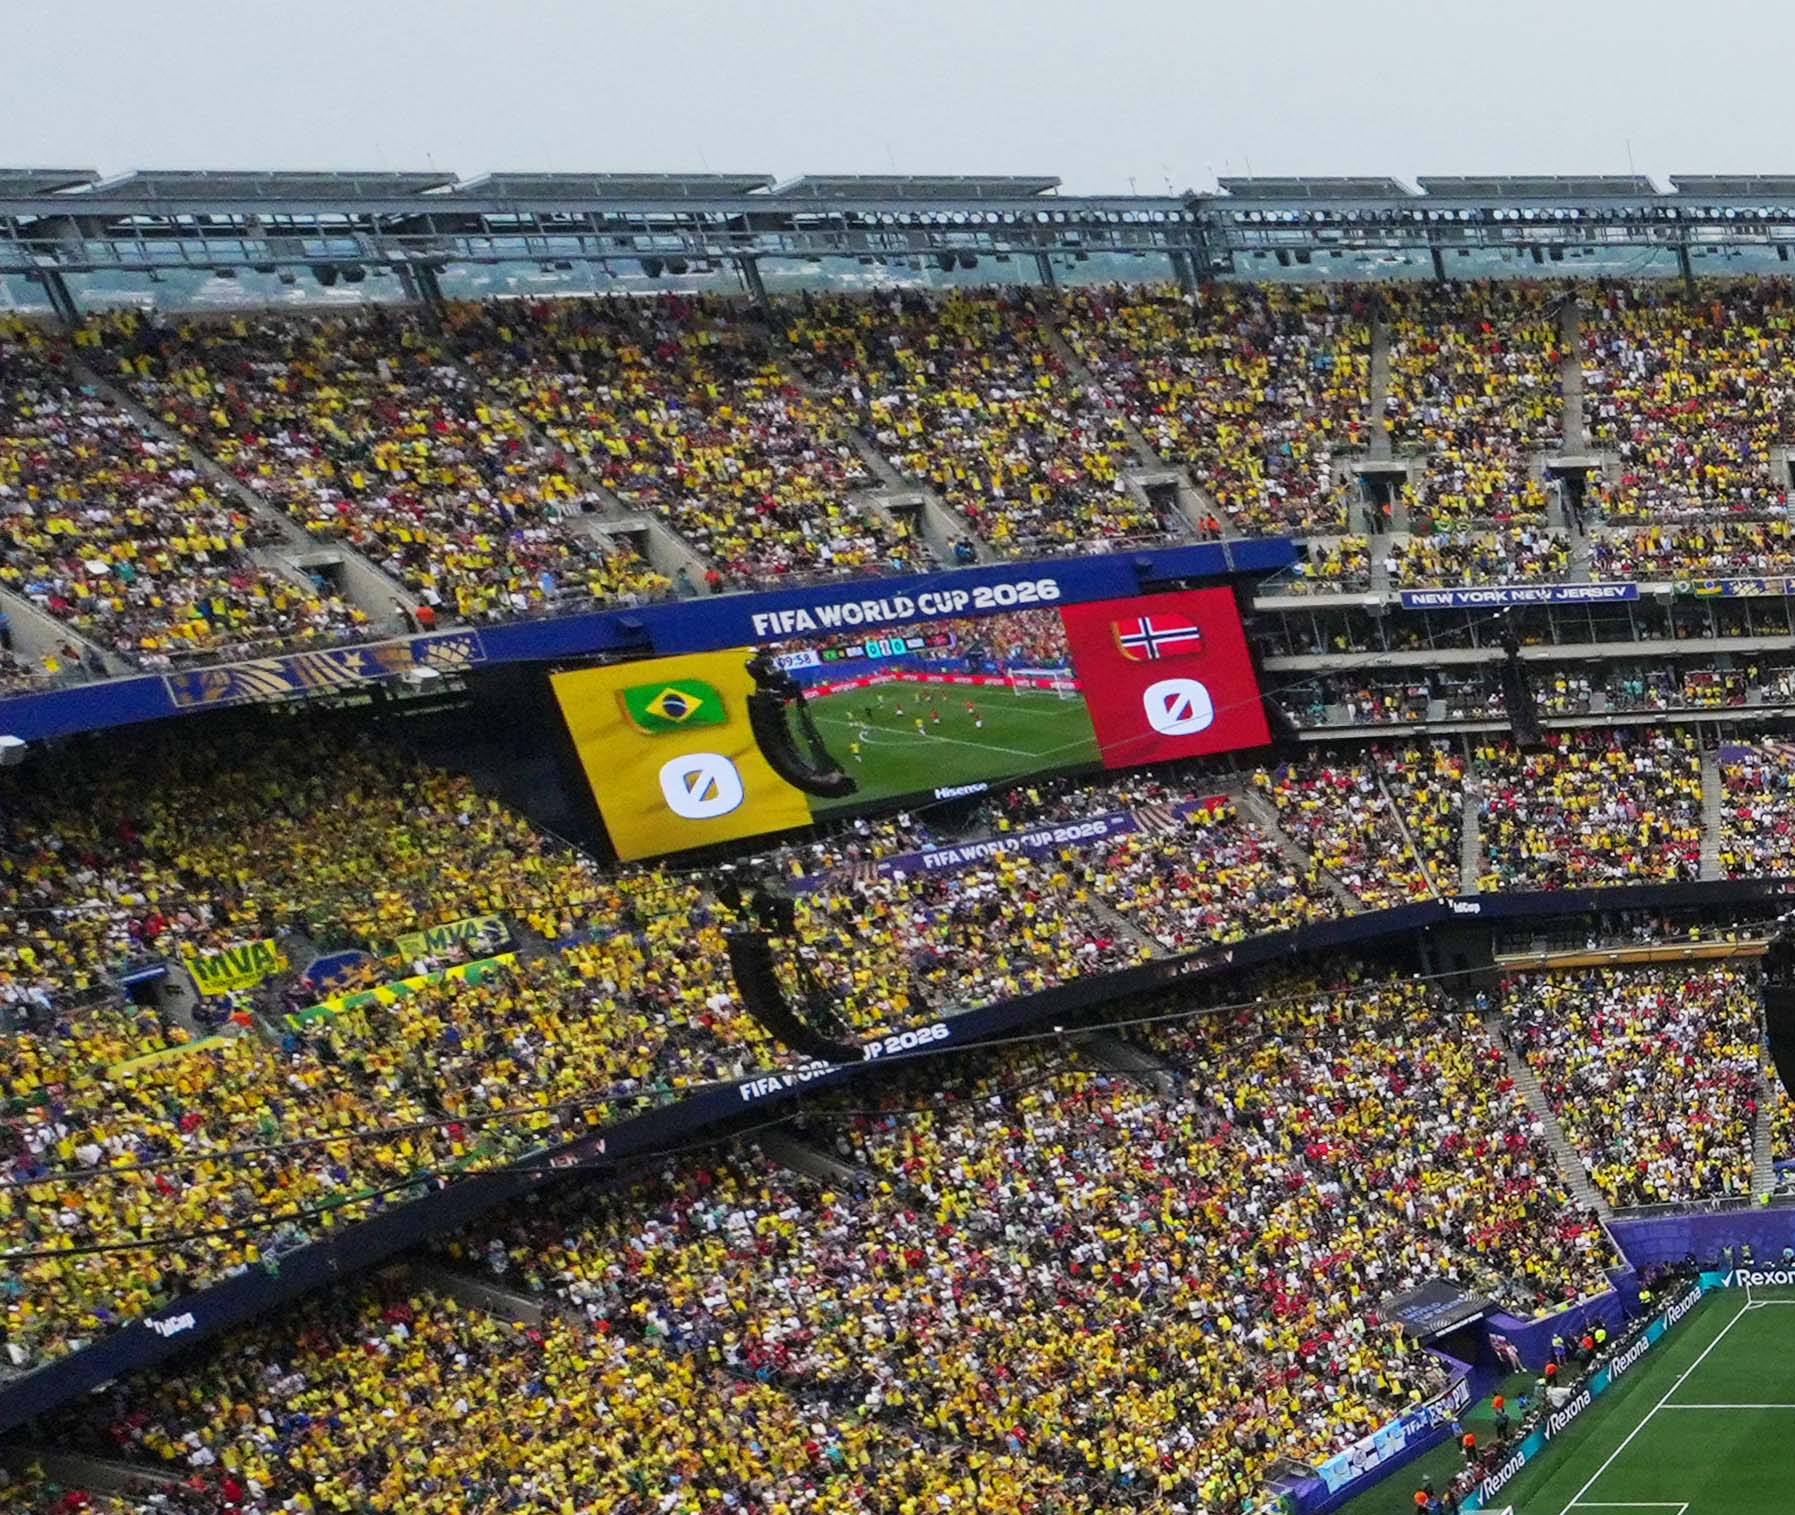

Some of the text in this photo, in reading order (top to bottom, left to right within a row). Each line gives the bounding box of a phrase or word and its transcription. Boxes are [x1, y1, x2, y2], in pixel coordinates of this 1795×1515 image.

[752, 579, 1061, 637] FIFA WORLD CUP 2026
[1411, 592, 1453, 605] NEW
[1456, 590, 1507, 603] YORK
[1556, 586, 1626, 599] JERSEY
[934, 781, 988, 800] Hisense
[923, 848, 959, 870] FIFA
[1053, 820, 1108, 844] 2026
[739, 1077, 783, 1101] FIFA
[884, 1023, 950, 1054] 2026
[1666, 1286, 1702, 1327] Rexona
[1613, 1335, 1650, 1377] Rexona
[1550, 1389, 1592, 1434] Rexona
[1483, 1450, 1526, 1497] Rexona
